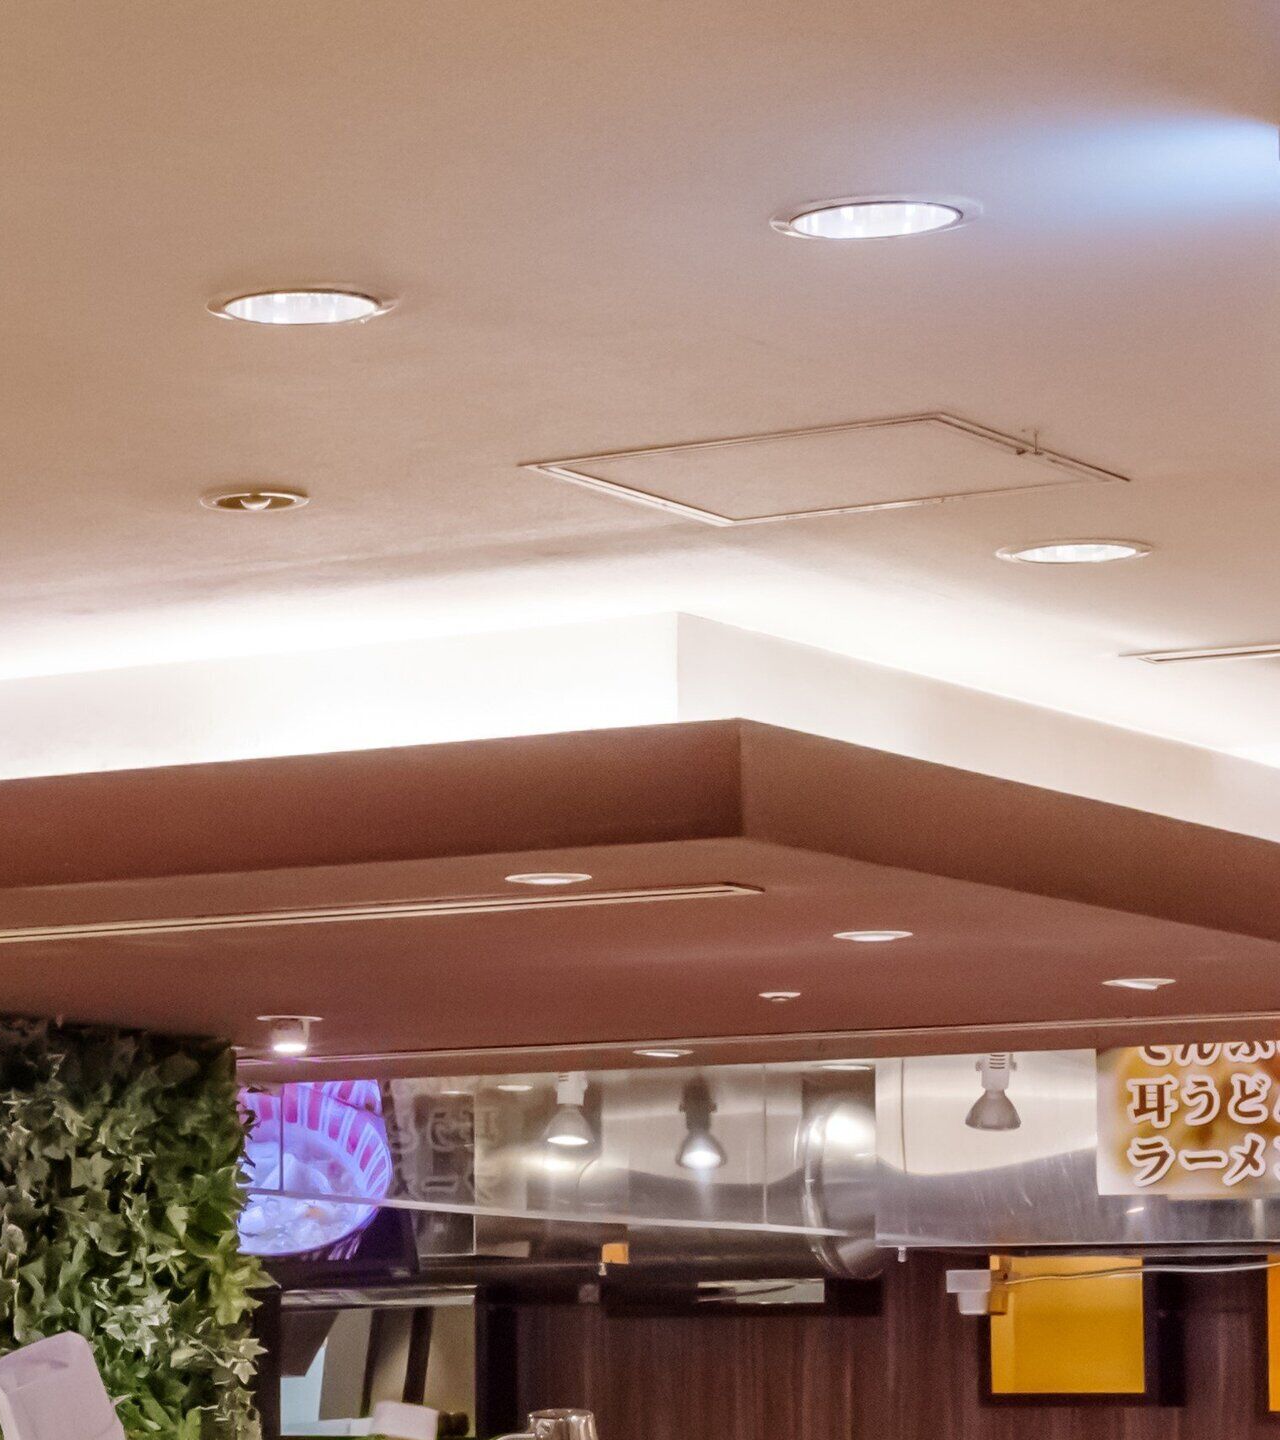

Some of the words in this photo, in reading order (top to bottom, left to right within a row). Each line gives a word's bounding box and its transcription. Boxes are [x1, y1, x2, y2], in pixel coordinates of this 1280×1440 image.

[1128, 1075, 1280, 1128] 耳うど
[1127, 1133, 1280, 1187] ラーメ
